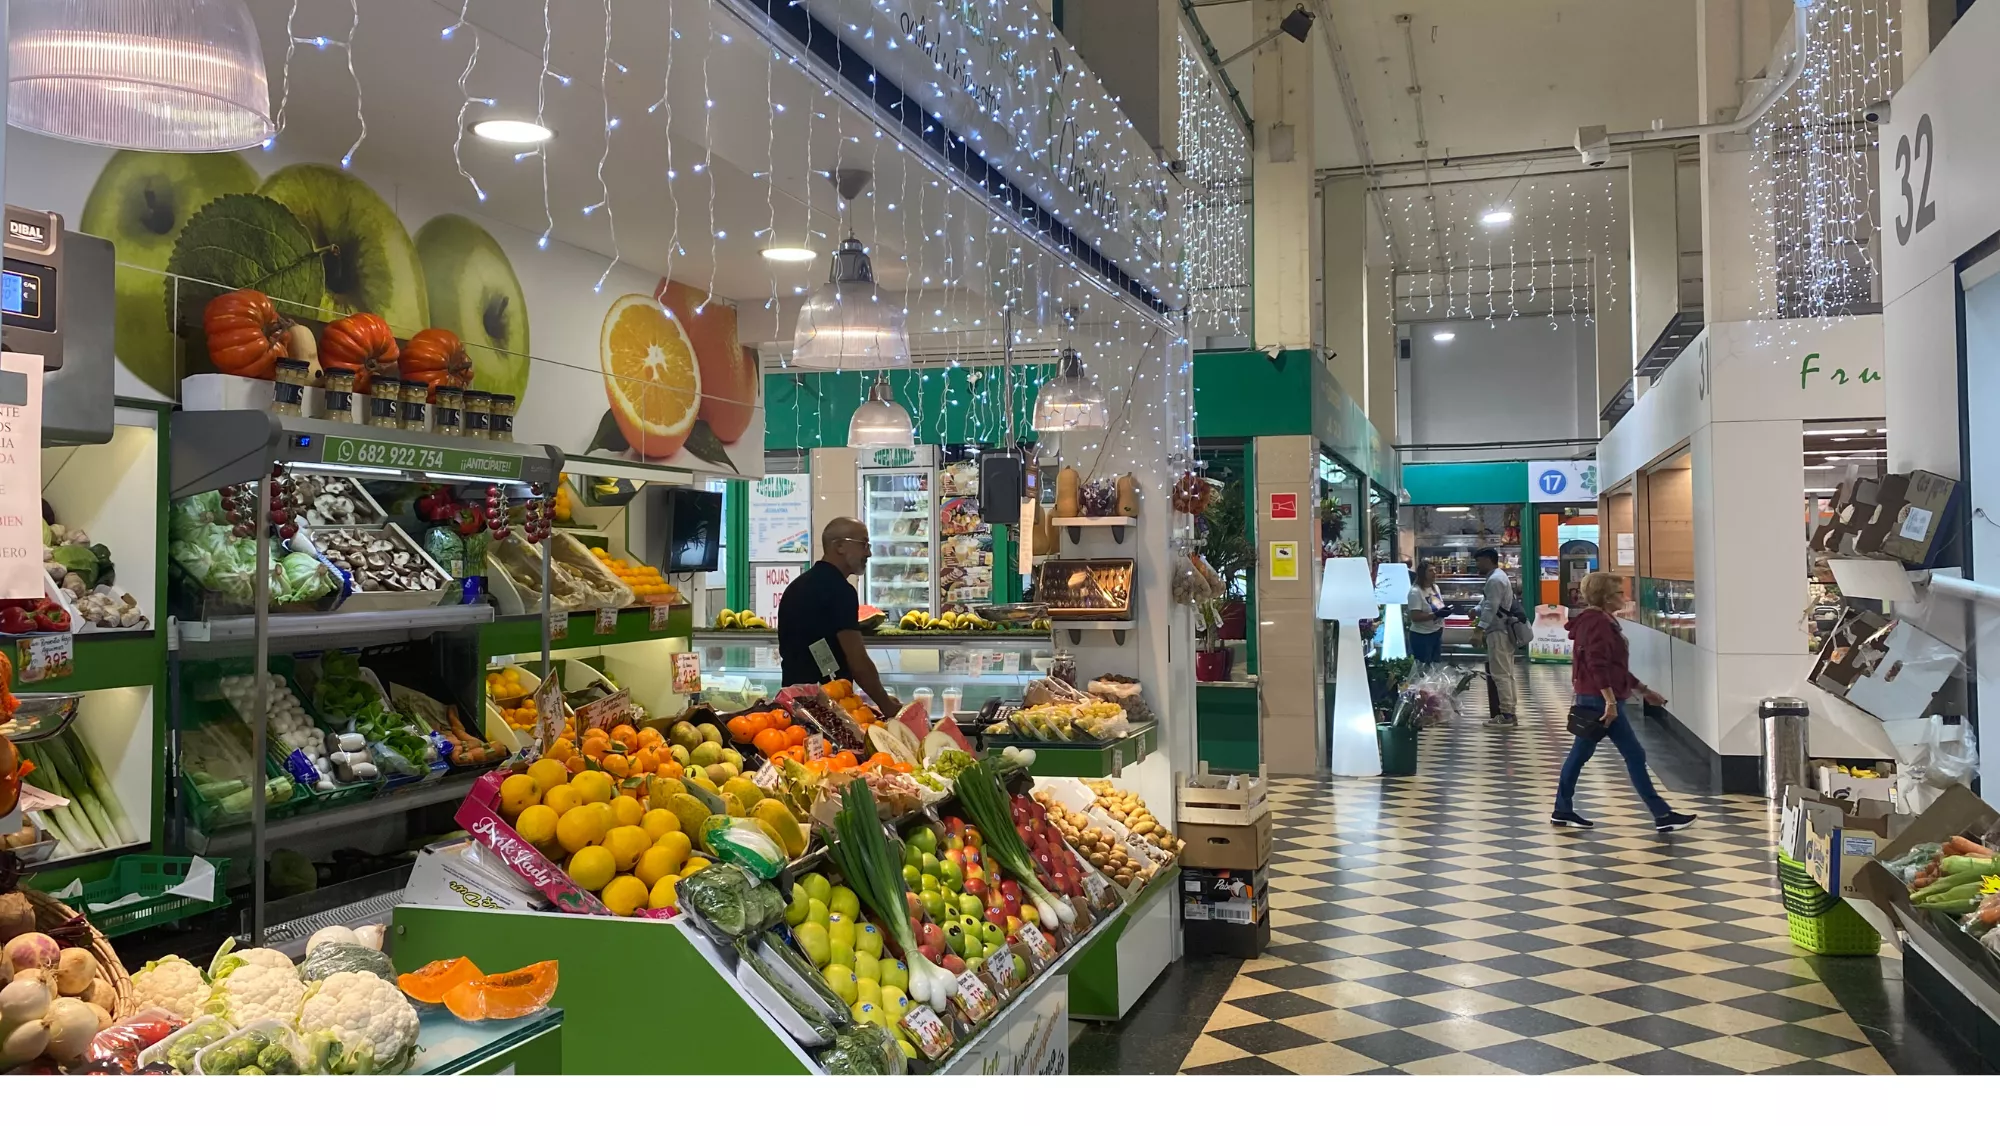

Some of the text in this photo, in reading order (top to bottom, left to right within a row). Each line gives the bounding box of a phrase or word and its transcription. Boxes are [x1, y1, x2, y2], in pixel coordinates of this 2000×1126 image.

[1895, 113, 1936, 246] 32
[10, 221, 44, 239] DIBAL
[1699, 337, 1709, 400] 31
[0, 437, 14, 448] IA
[358, 443, 386, 464] 682
[390, 446, 416, 467] 922
[419, 449, 444, 468] 754
[1543, 474, 1563, 491] 17
[0, 546, 27, 558] ERO
[766, 568, 790, 585] HOJAS
[472, 816, 516, 855] Pink
[511, 850, 552, 887] Lady
